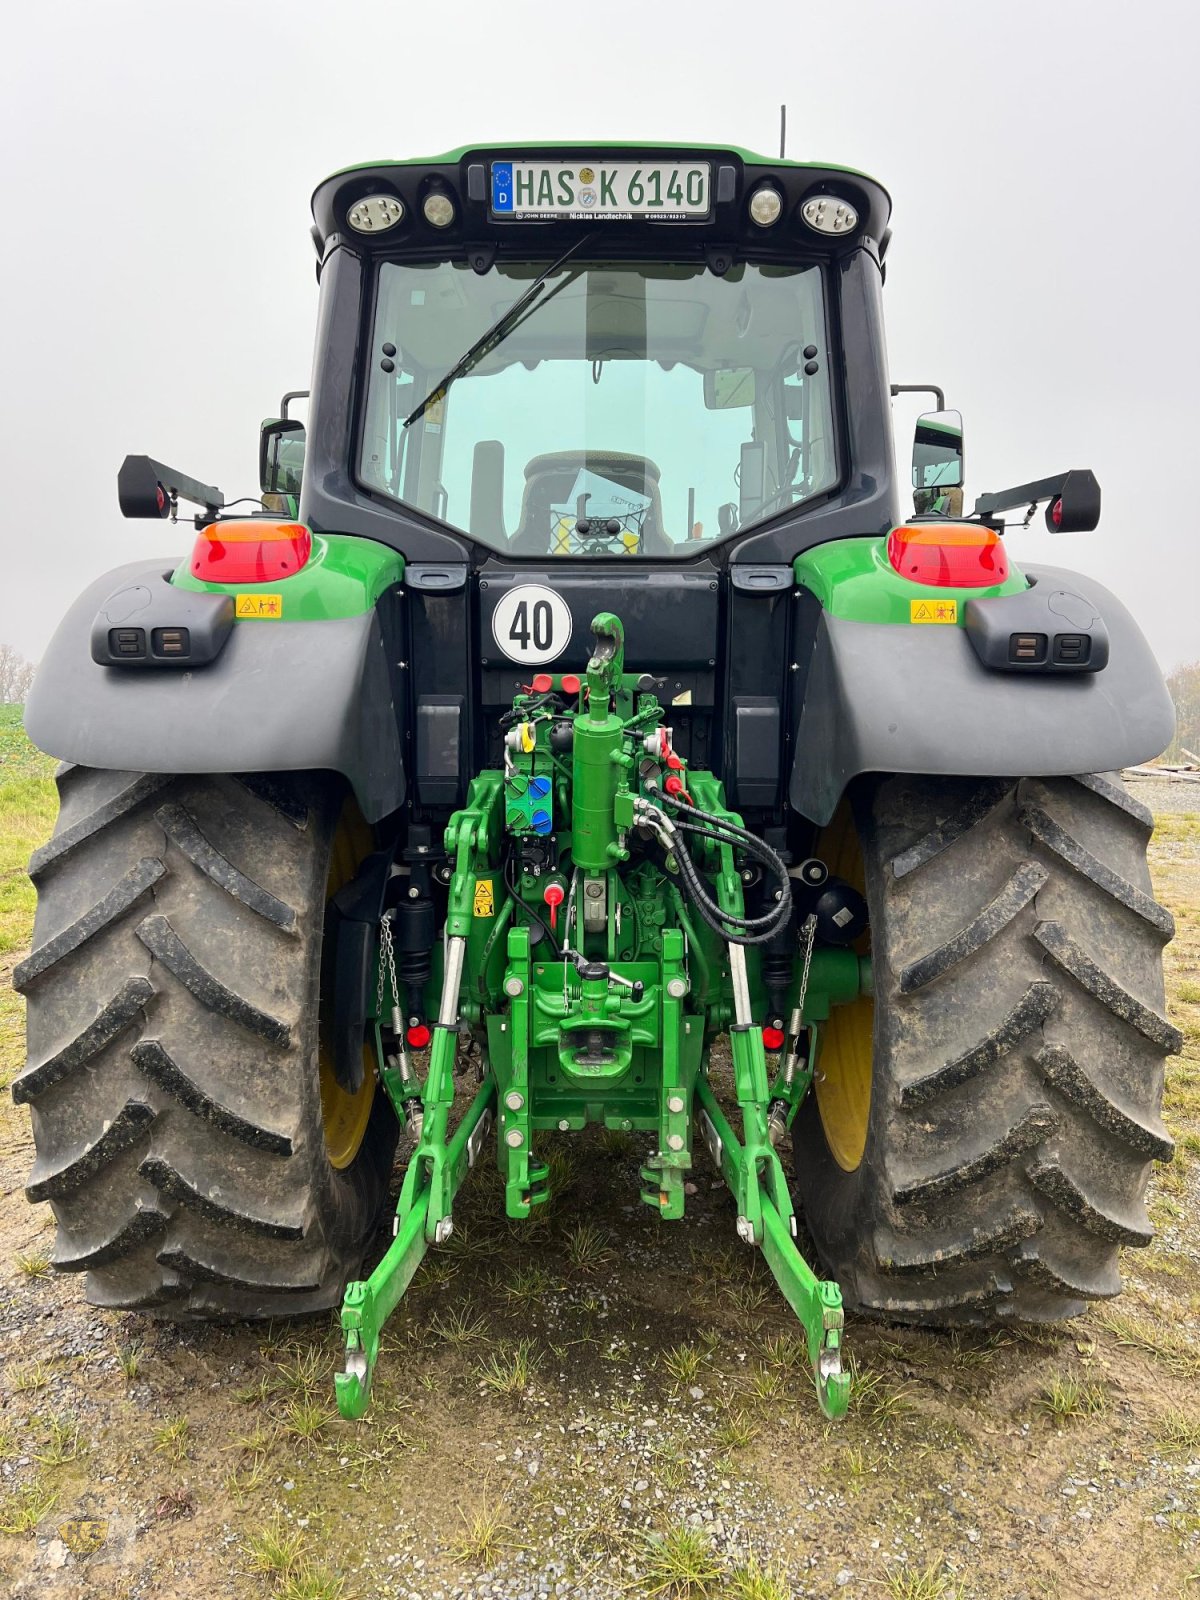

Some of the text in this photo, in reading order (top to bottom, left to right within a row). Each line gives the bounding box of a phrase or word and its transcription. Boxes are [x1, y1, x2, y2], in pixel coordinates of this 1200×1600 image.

[499, 192, 507, 204] D
[516, 169, 704, 206] HAS K 6140
[594, 212, 633, 220] Landtechnik
[509, 600, 553, 651] 40
